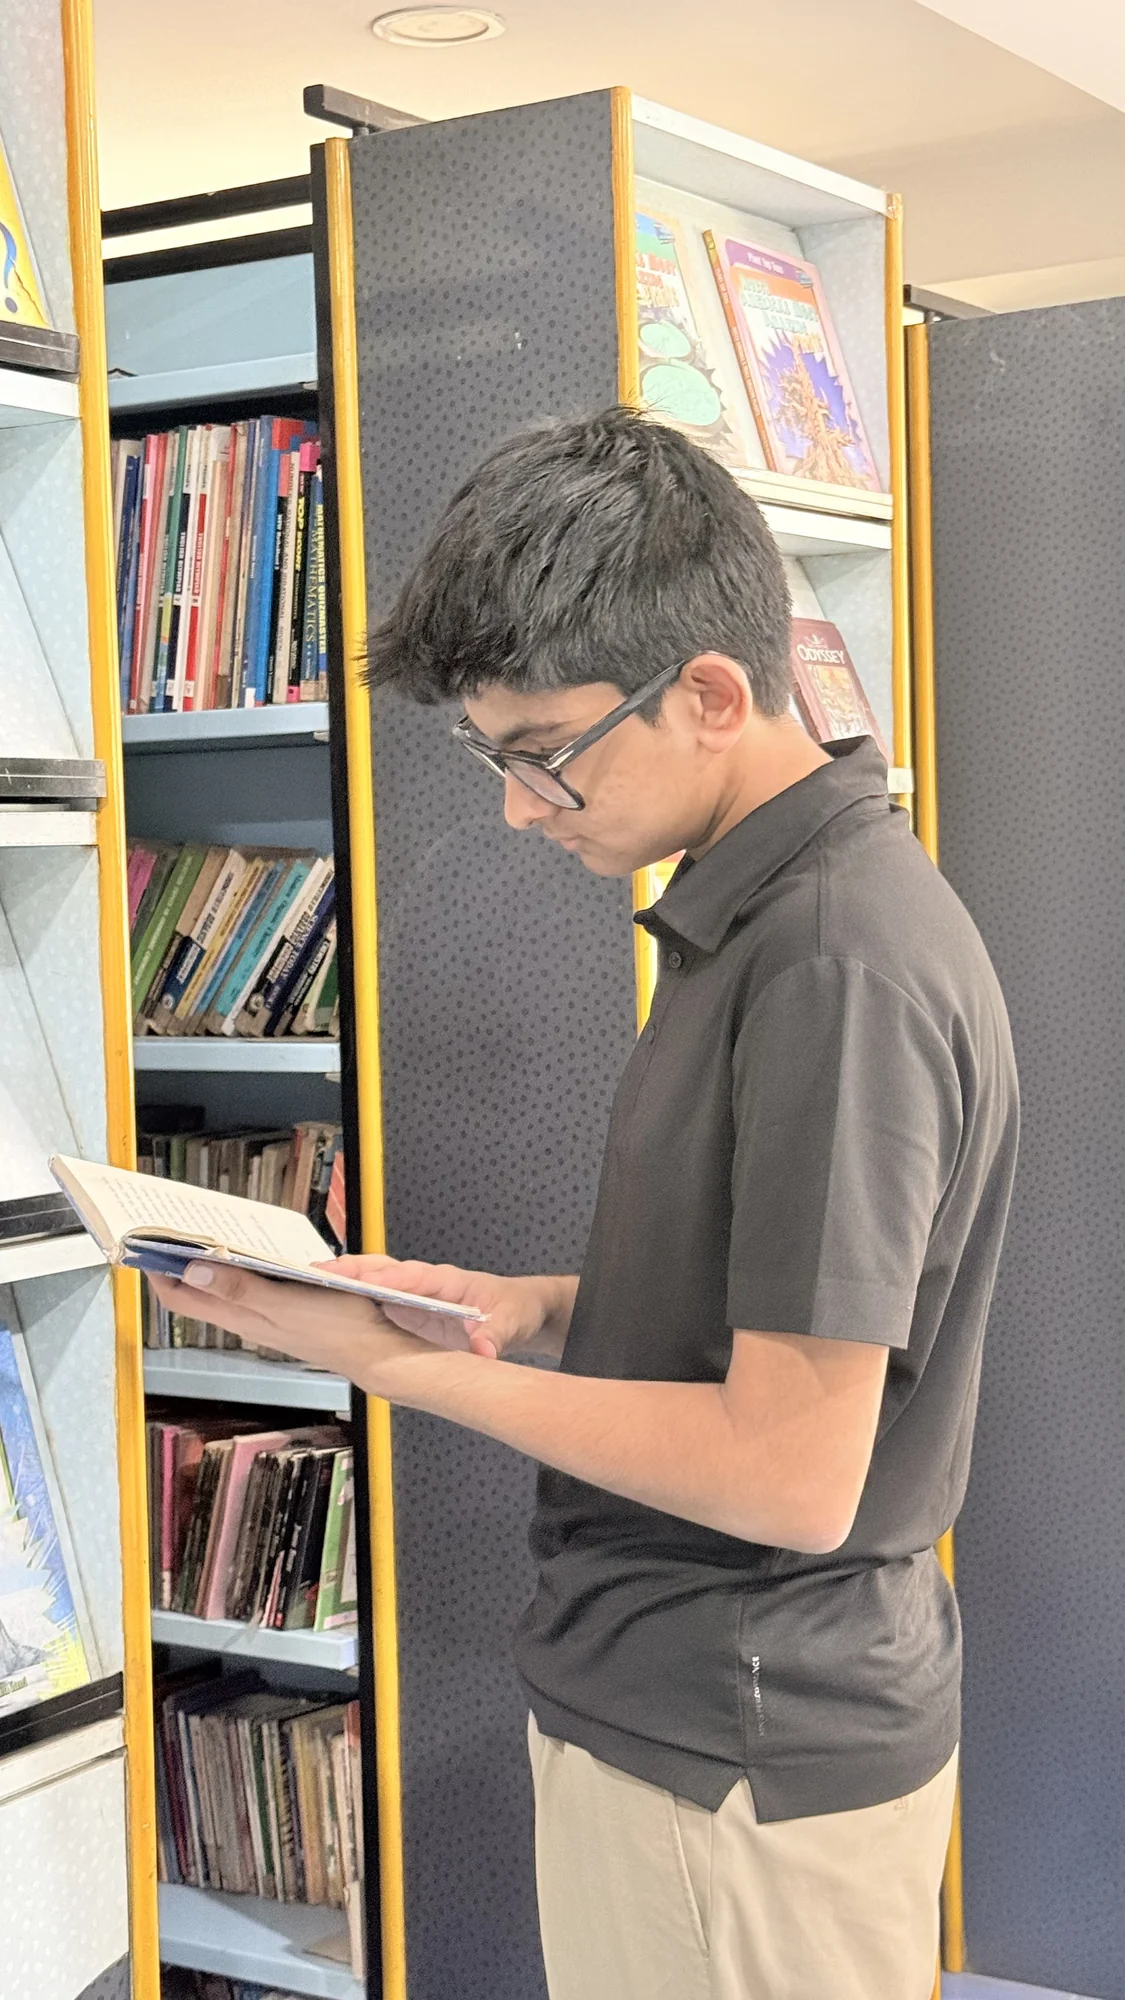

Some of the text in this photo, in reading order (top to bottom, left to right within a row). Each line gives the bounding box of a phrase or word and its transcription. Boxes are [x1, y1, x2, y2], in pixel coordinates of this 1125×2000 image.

[297, 496, 305, 529] TOP
[295, 530, 303, 572] SCORE
[305, 529, 317, 642] MATHEMATICS
[316, 503, 327, 655] MATHEMATICS QUIZMASTER
[796, 643, 846, 665] ODYSSEY
[279, 948, 300, 980] TODAY
